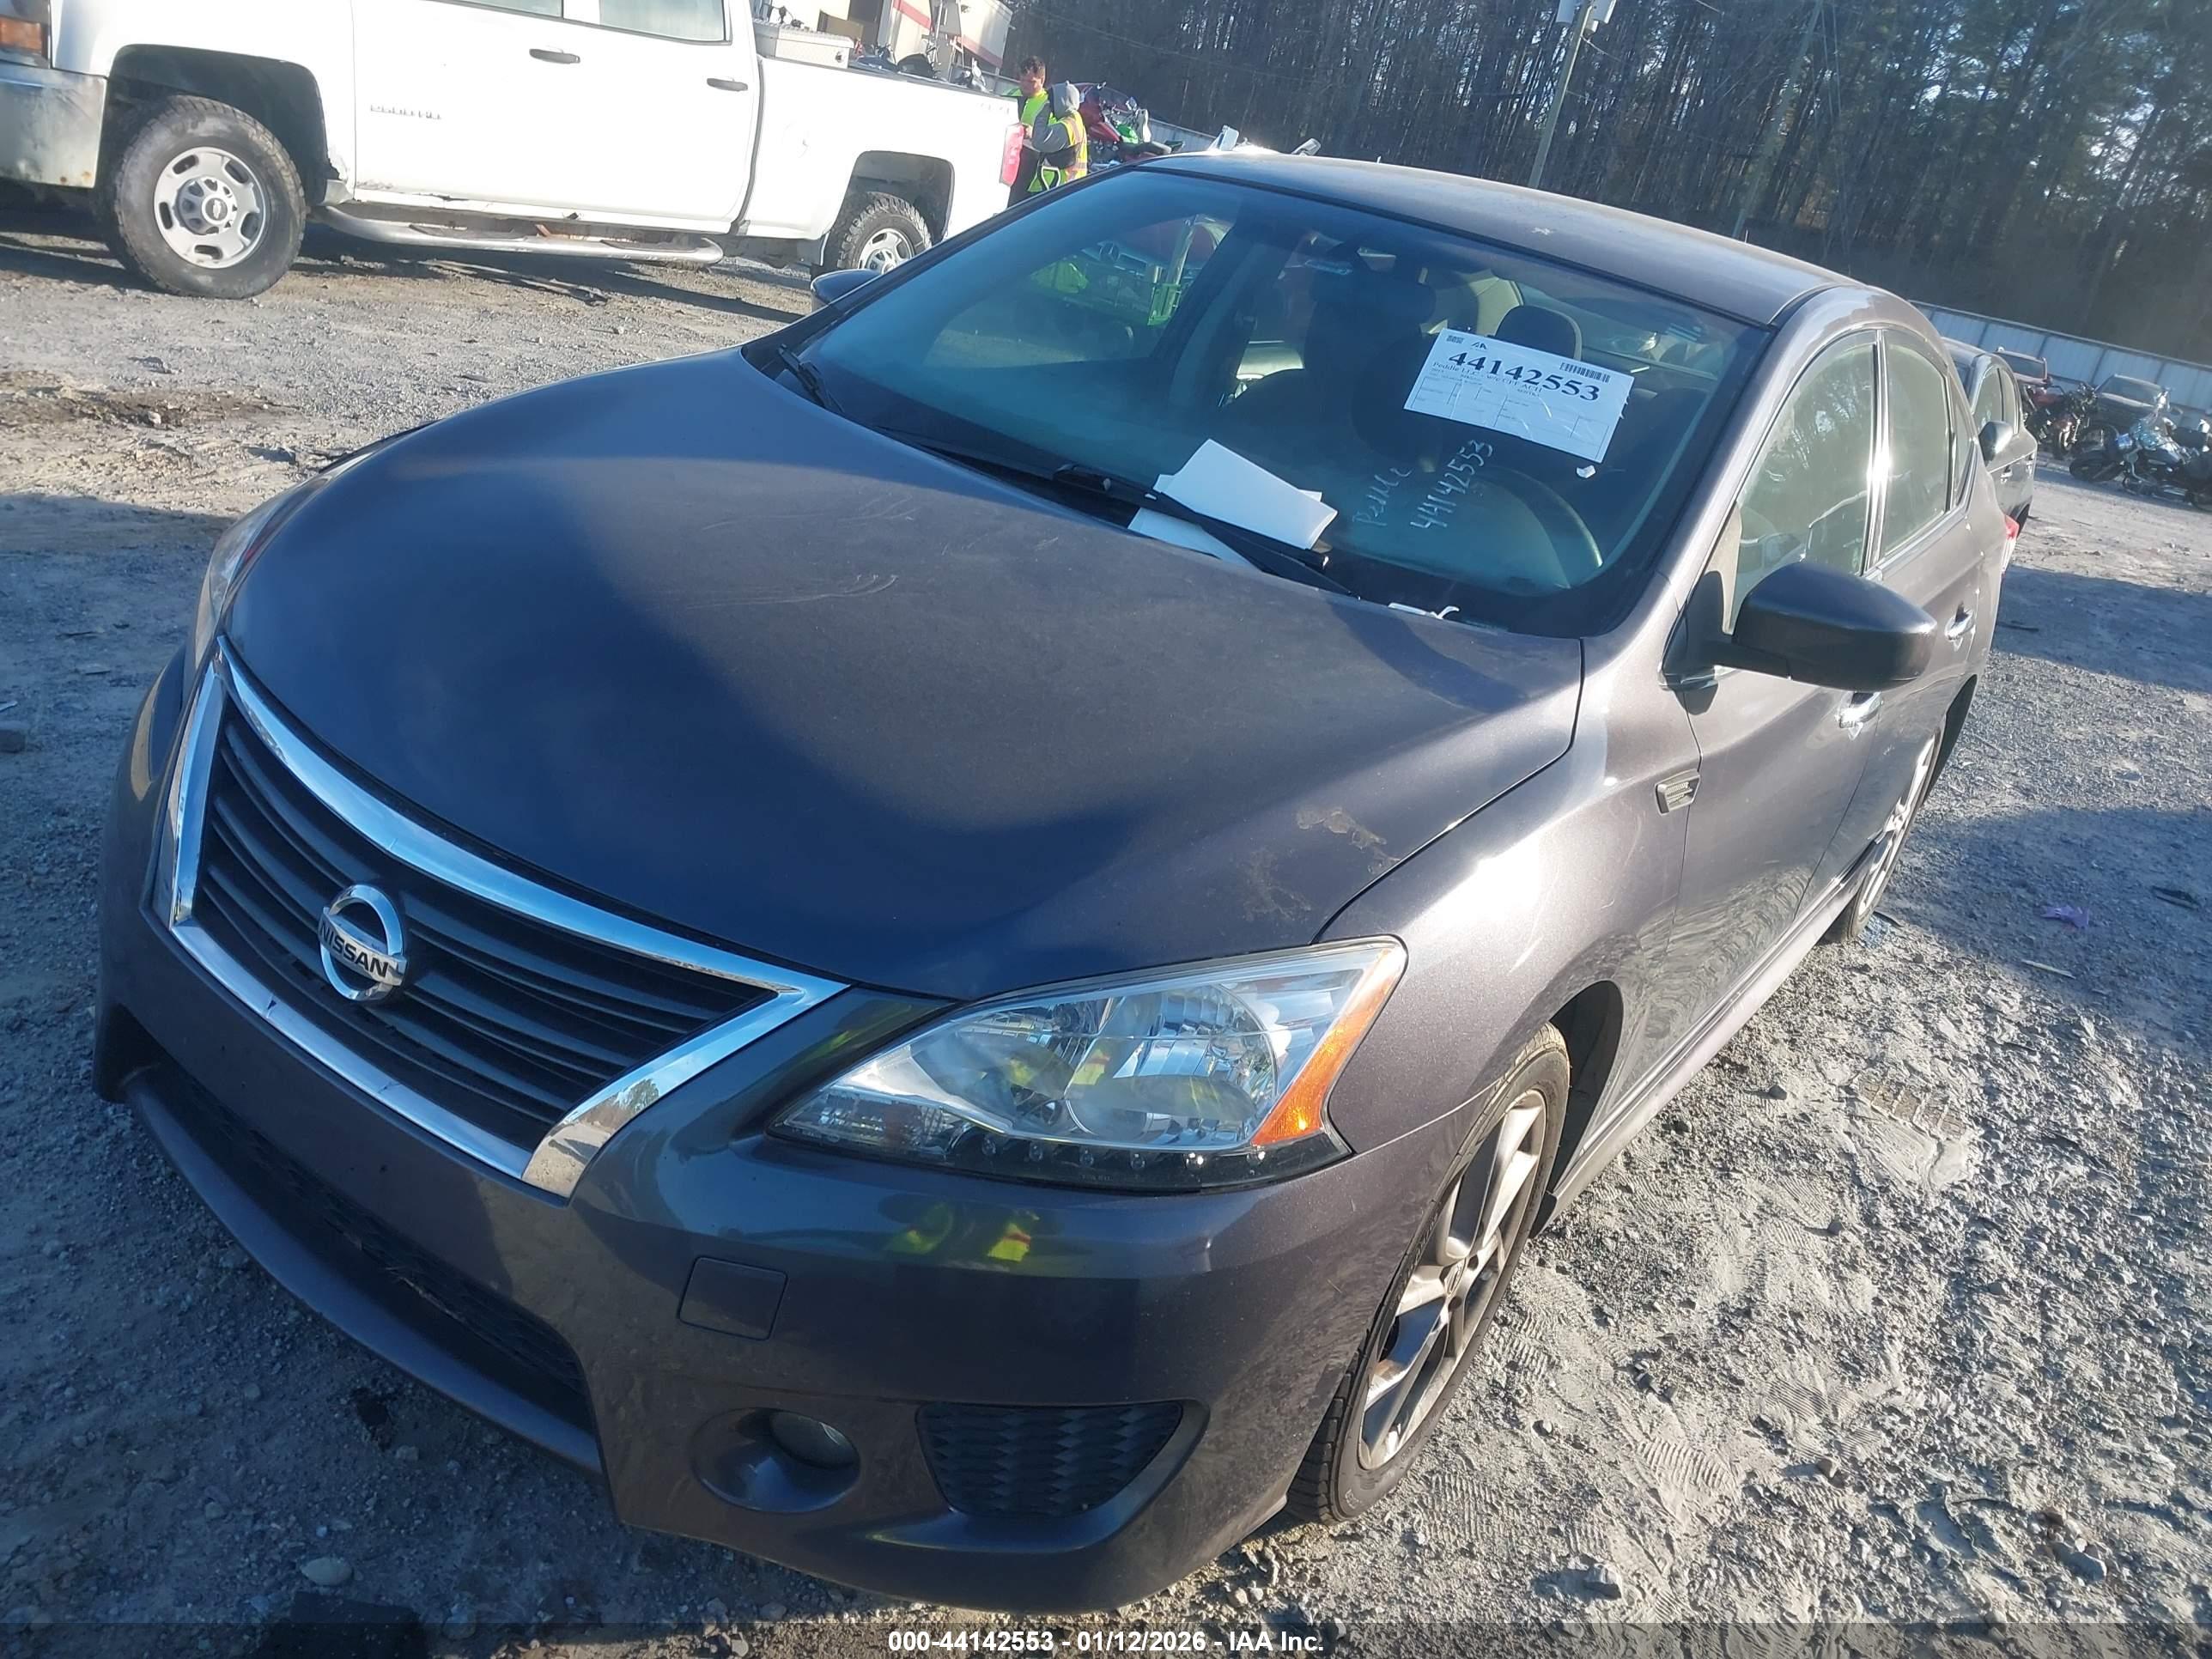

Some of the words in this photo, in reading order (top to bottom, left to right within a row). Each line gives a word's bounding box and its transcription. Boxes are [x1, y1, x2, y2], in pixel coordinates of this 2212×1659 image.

[1448, 351, 1601, 402] 44142553
[1409, 439, 1493, 529] 44142553
[319, 923, 390, 978] NISSAN
